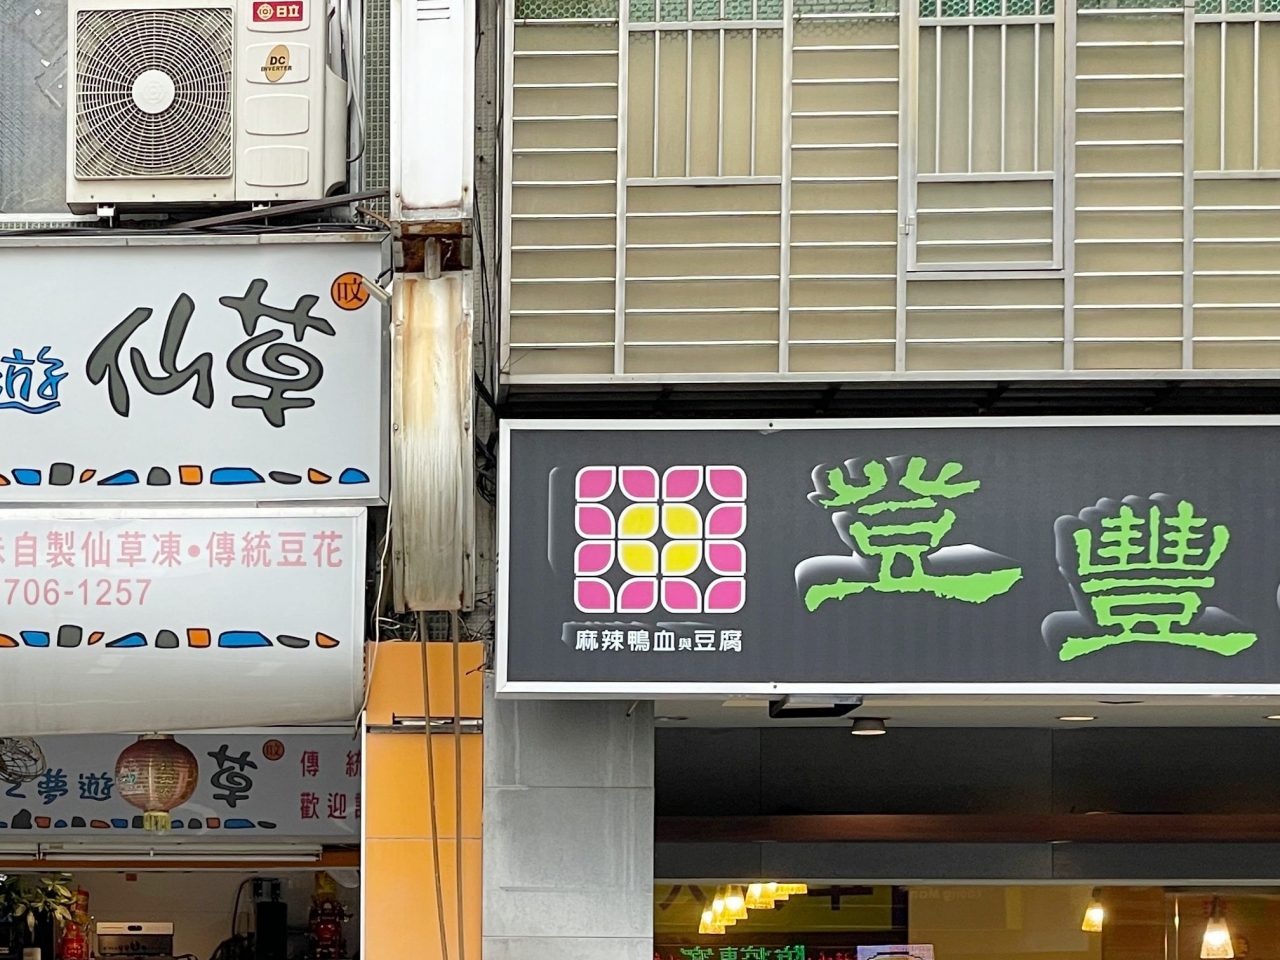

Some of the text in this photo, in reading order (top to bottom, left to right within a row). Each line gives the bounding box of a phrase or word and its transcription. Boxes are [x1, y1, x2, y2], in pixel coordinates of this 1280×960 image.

[269, 56, 286, 65] DC
[575, 630, 742, 652] 麻辣鴨血與豆腐
